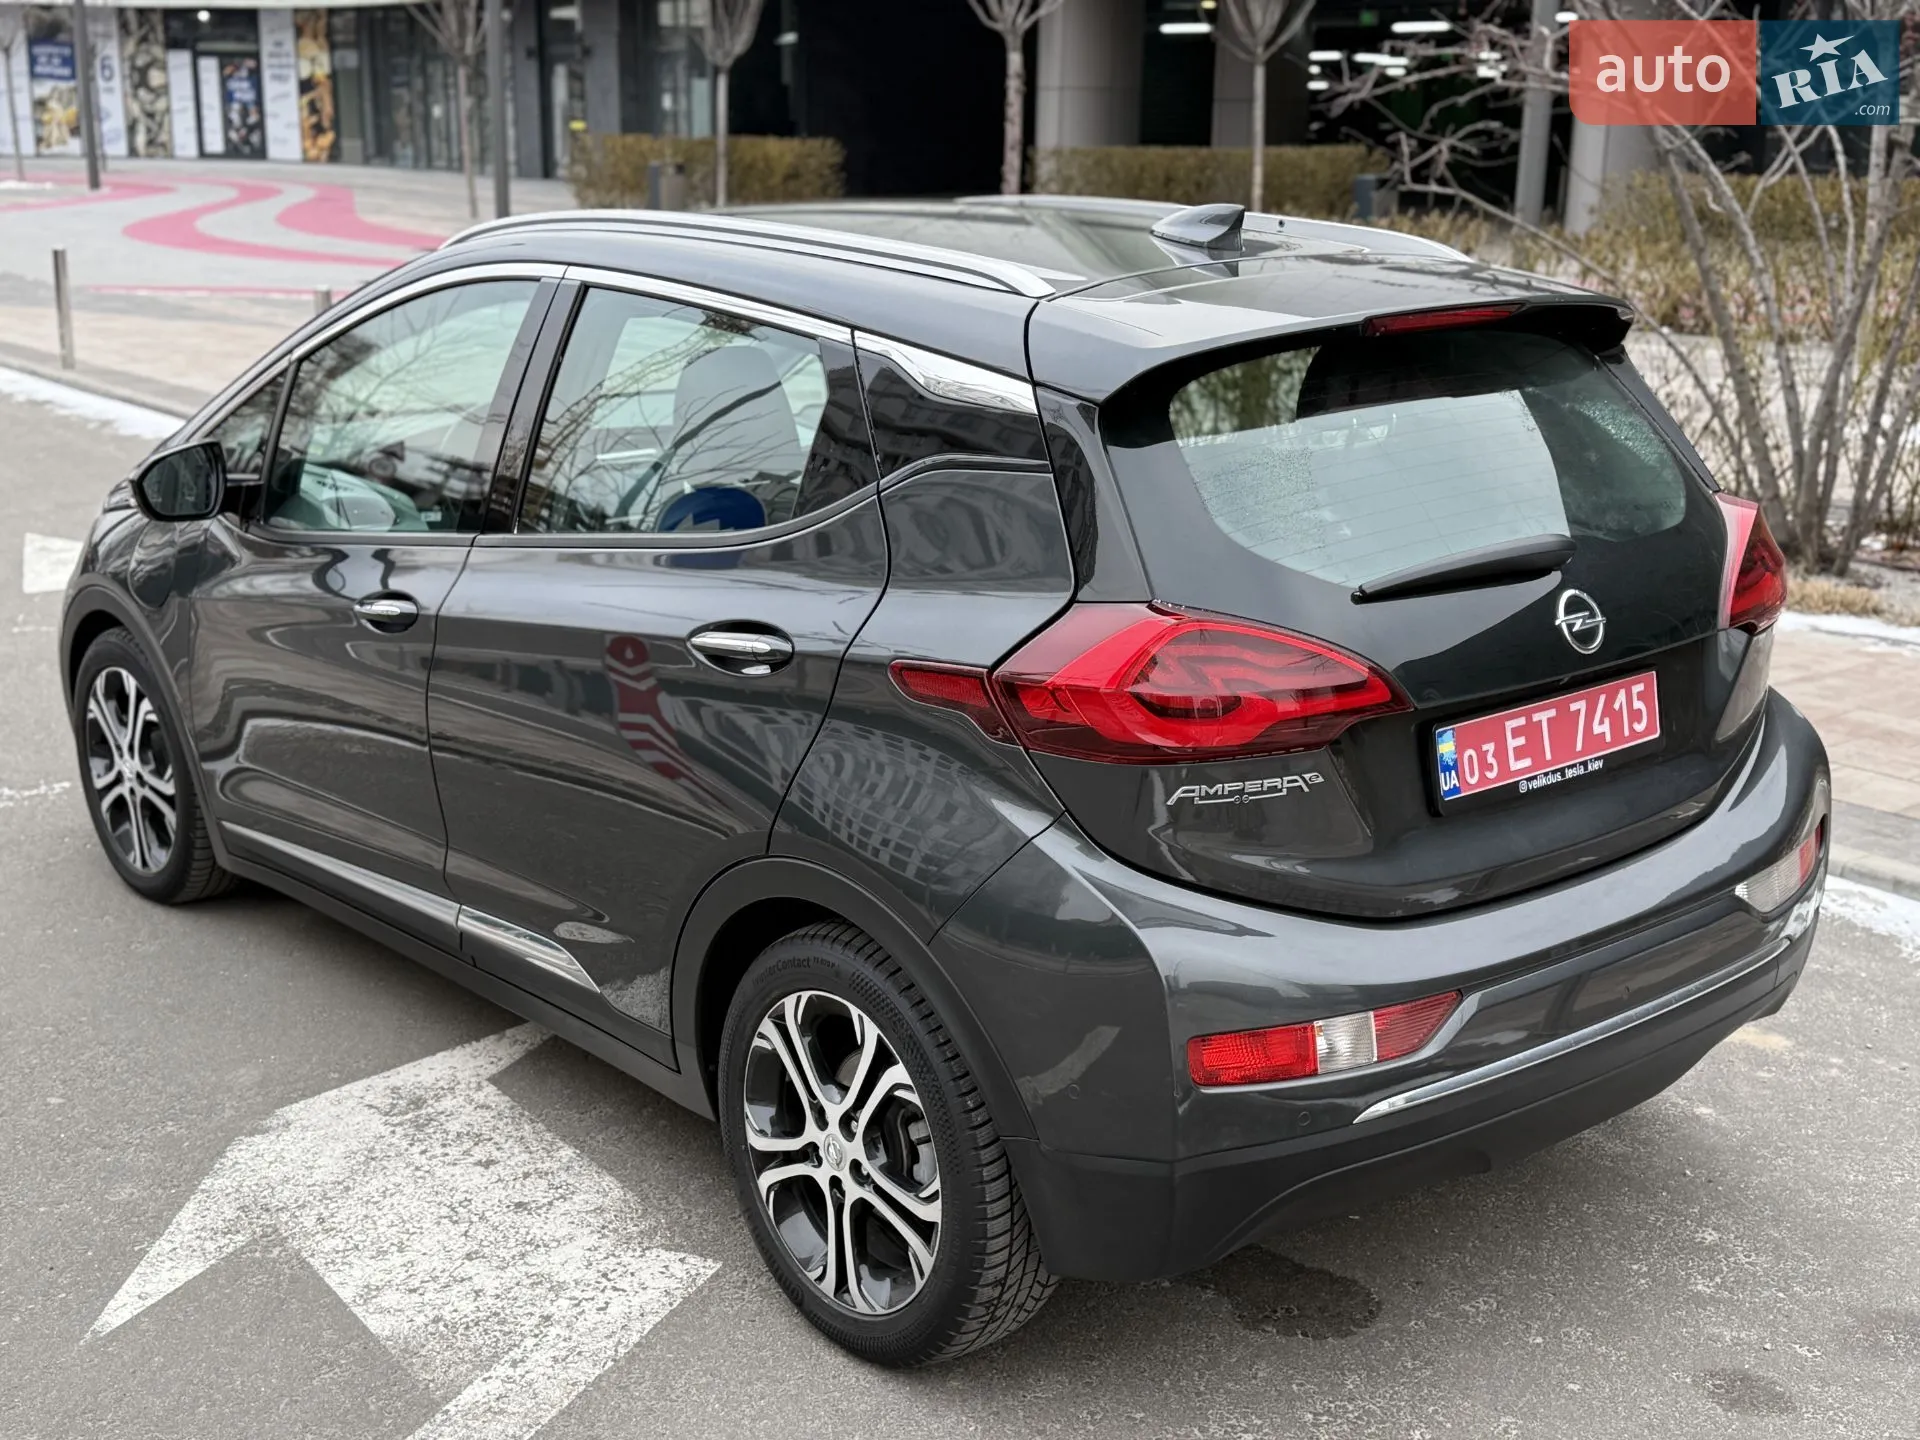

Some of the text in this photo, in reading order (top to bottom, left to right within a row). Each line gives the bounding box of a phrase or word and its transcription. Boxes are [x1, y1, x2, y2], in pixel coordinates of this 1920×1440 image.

[1463, 682, 1648, 785] 03 ET 7415
[1441, 772, 1459, 791] UA
